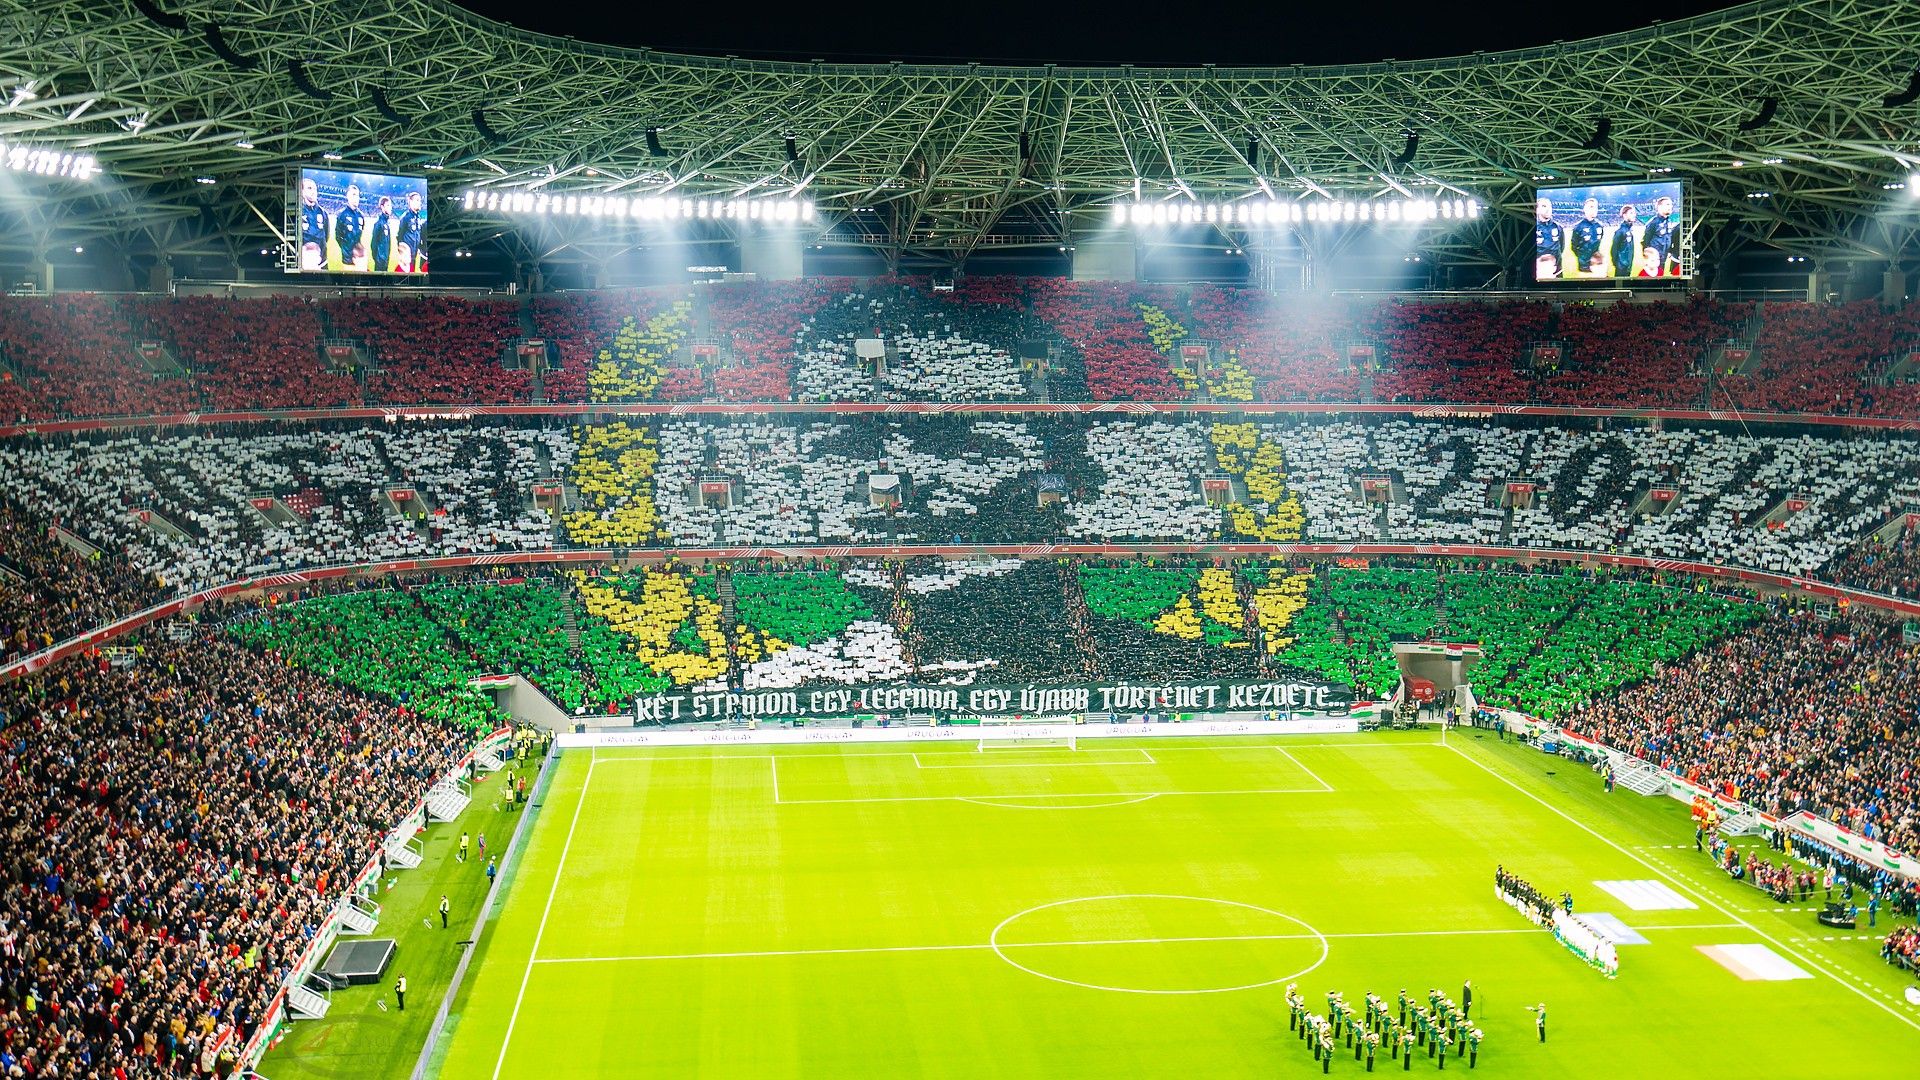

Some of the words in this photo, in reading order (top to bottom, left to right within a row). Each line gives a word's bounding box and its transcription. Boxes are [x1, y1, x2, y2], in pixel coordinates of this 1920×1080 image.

[636, 694, 686, 722] KÉT
[693, 691, 805, 718] STADION,
[811, 690, 851, 712] EGY
[860, 688, 964, 711] LEGENDA,
[970, 688, 1012, 710] EGY
[1020, 685, 1088, 714] ÚJABB
[1098, 682, 1220, 709] TÖRTÉNET
